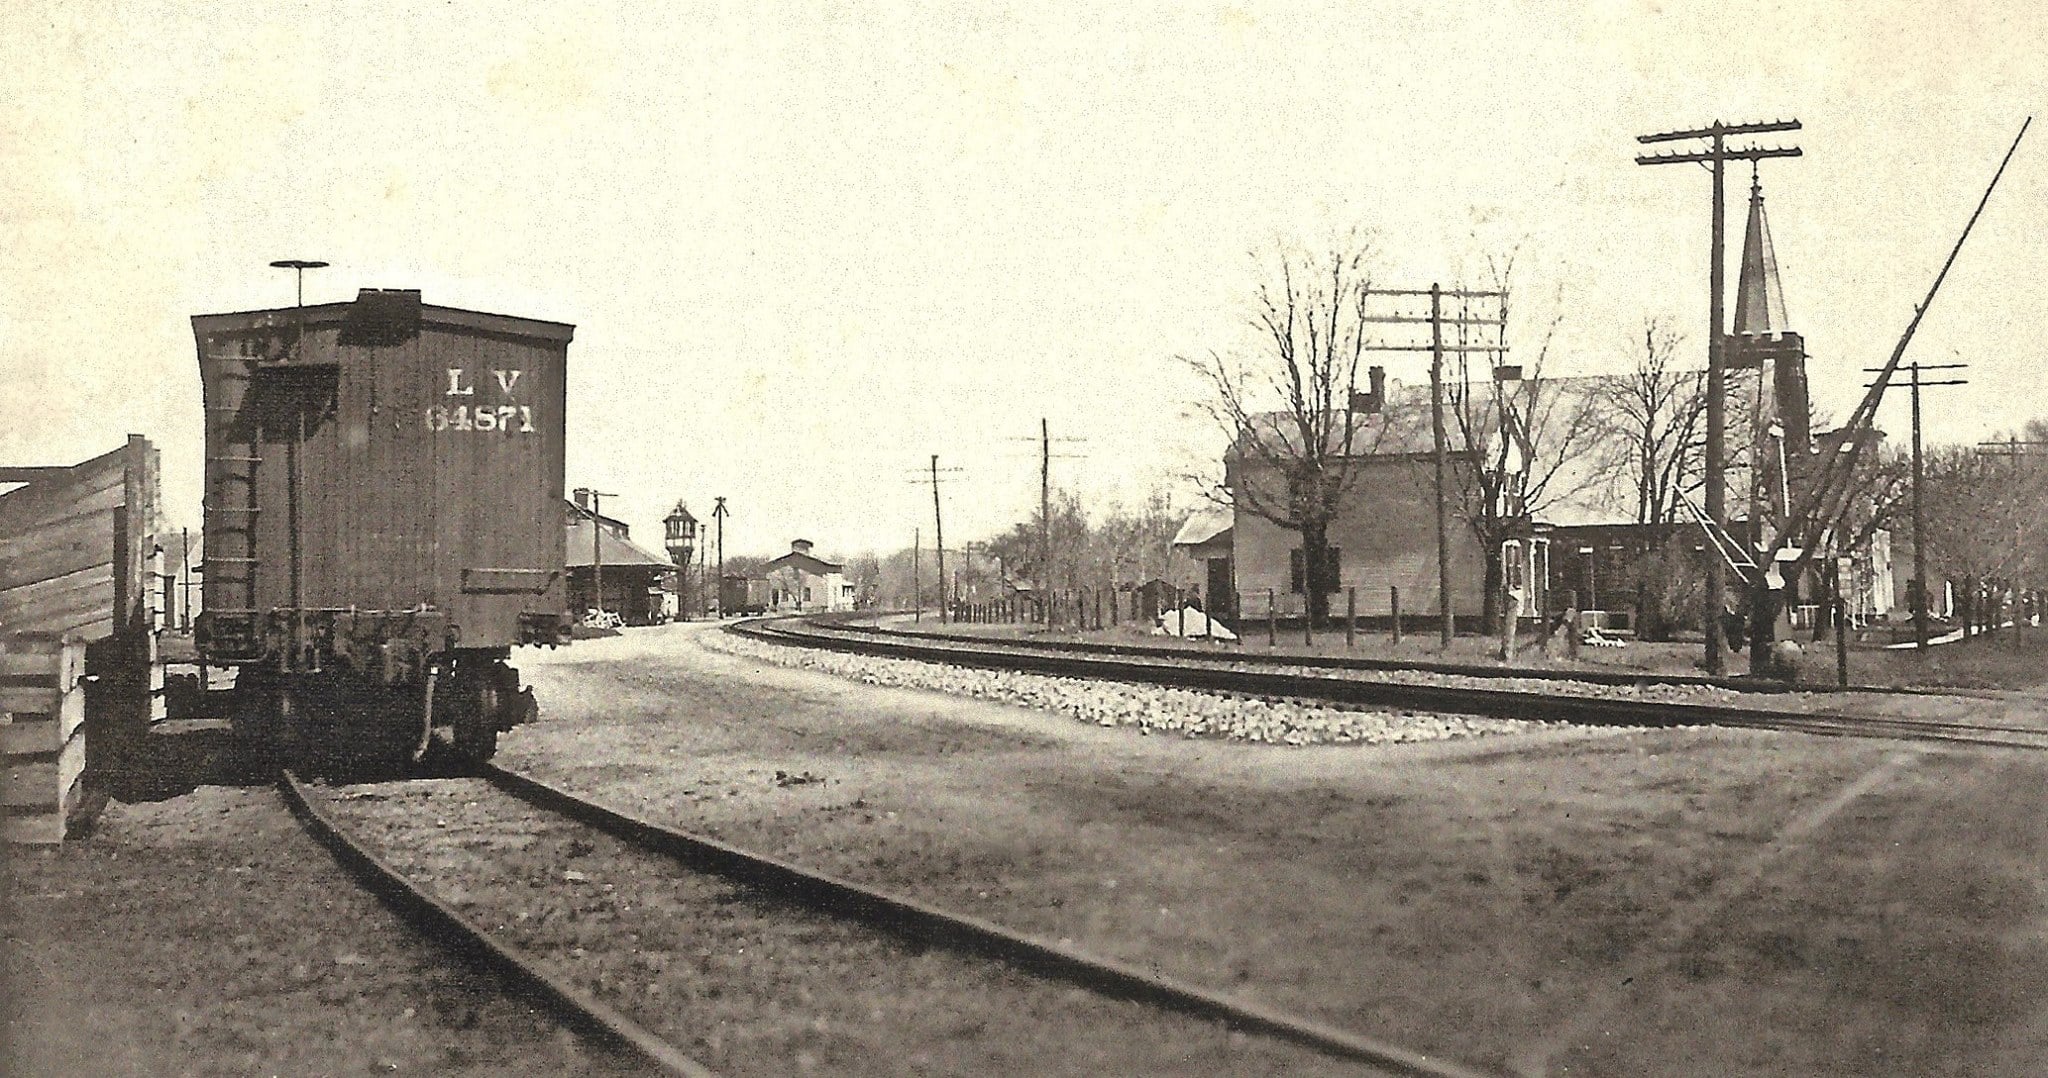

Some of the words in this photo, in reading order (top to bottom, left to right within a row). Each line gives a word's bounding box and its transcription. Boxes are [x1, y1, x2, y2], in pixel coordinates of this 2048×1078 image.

[446, 368, 474, 396] L
[493, 369, 522, 394] V
[425, 405, 535, 433] 64871
